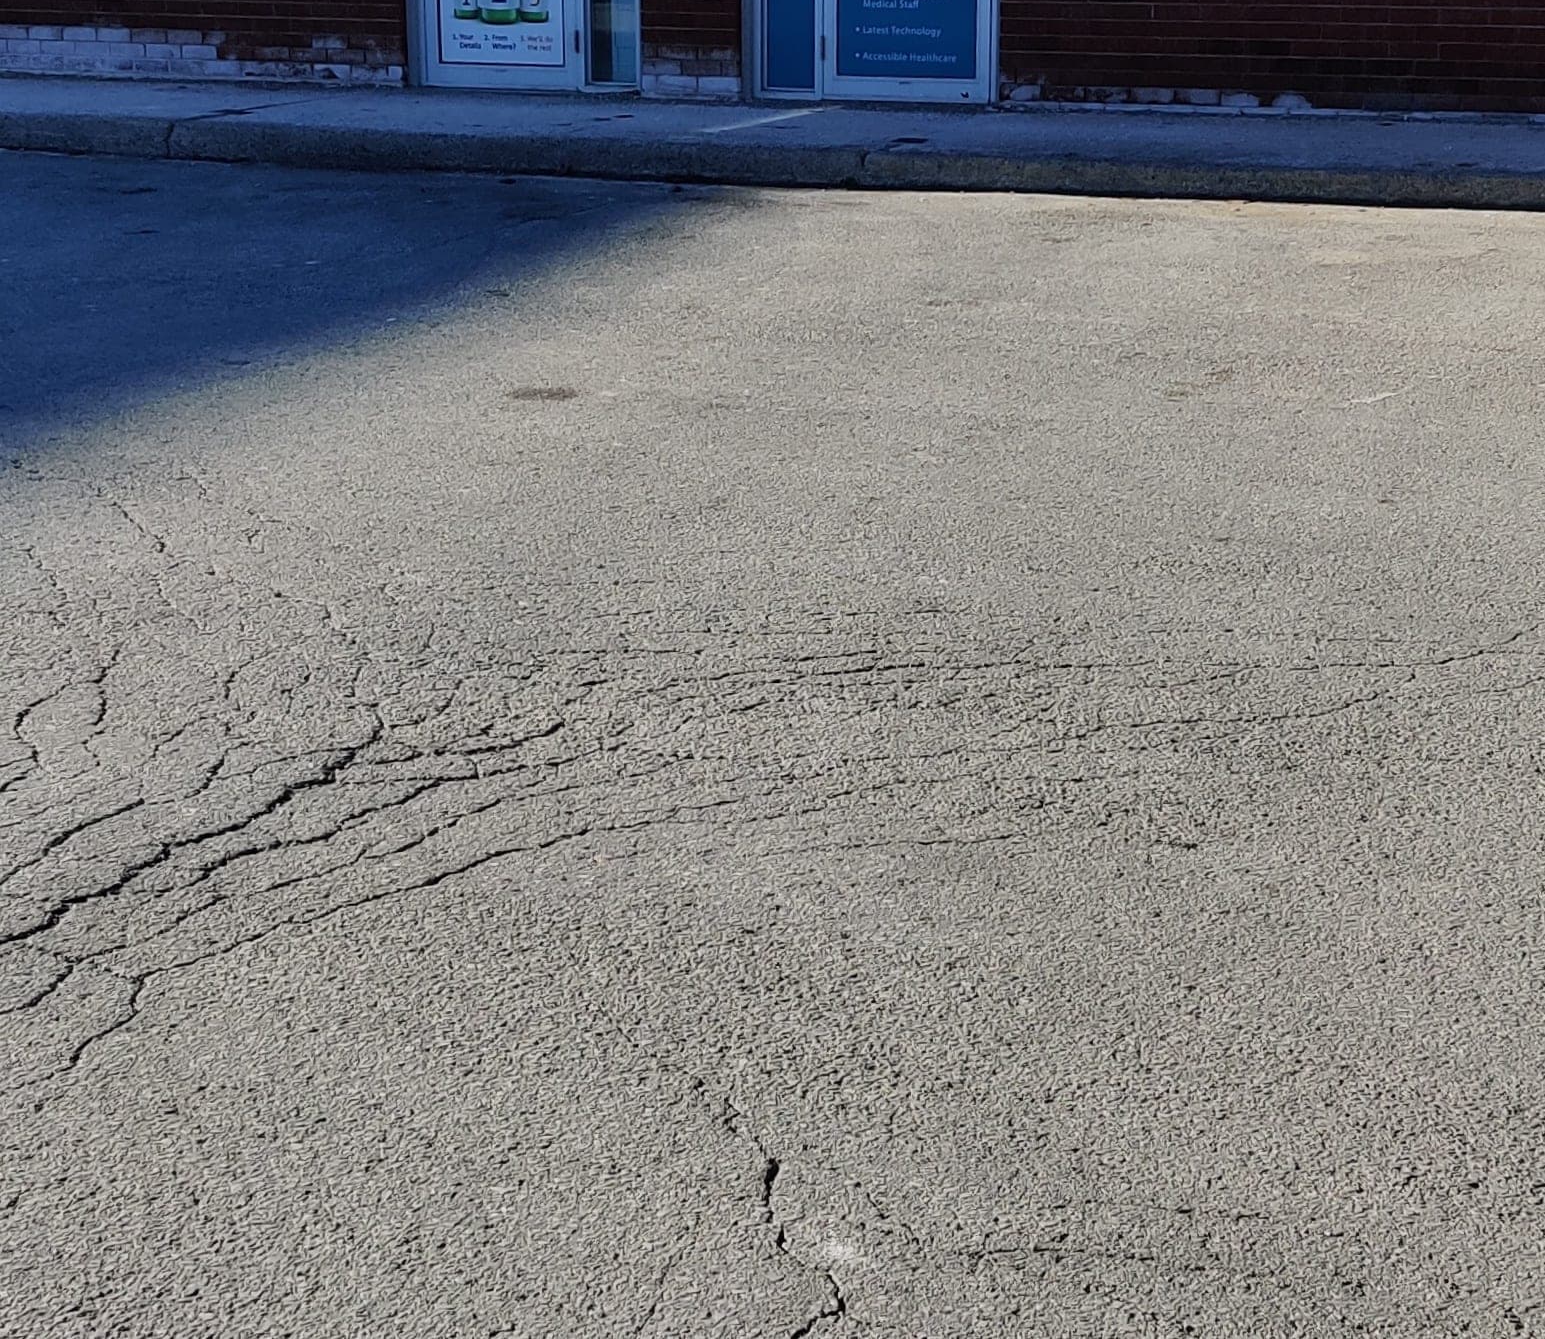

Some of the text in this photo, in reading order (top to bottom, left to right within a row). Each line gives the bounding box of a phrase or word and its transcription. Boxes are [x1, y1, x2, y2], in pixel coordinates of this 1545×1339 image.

[862, 0, 920, 9] Medical Staff
[862, 25, 941, 38] Latest Technology
[862, 52, 957, 63] Accessible Healthcare
